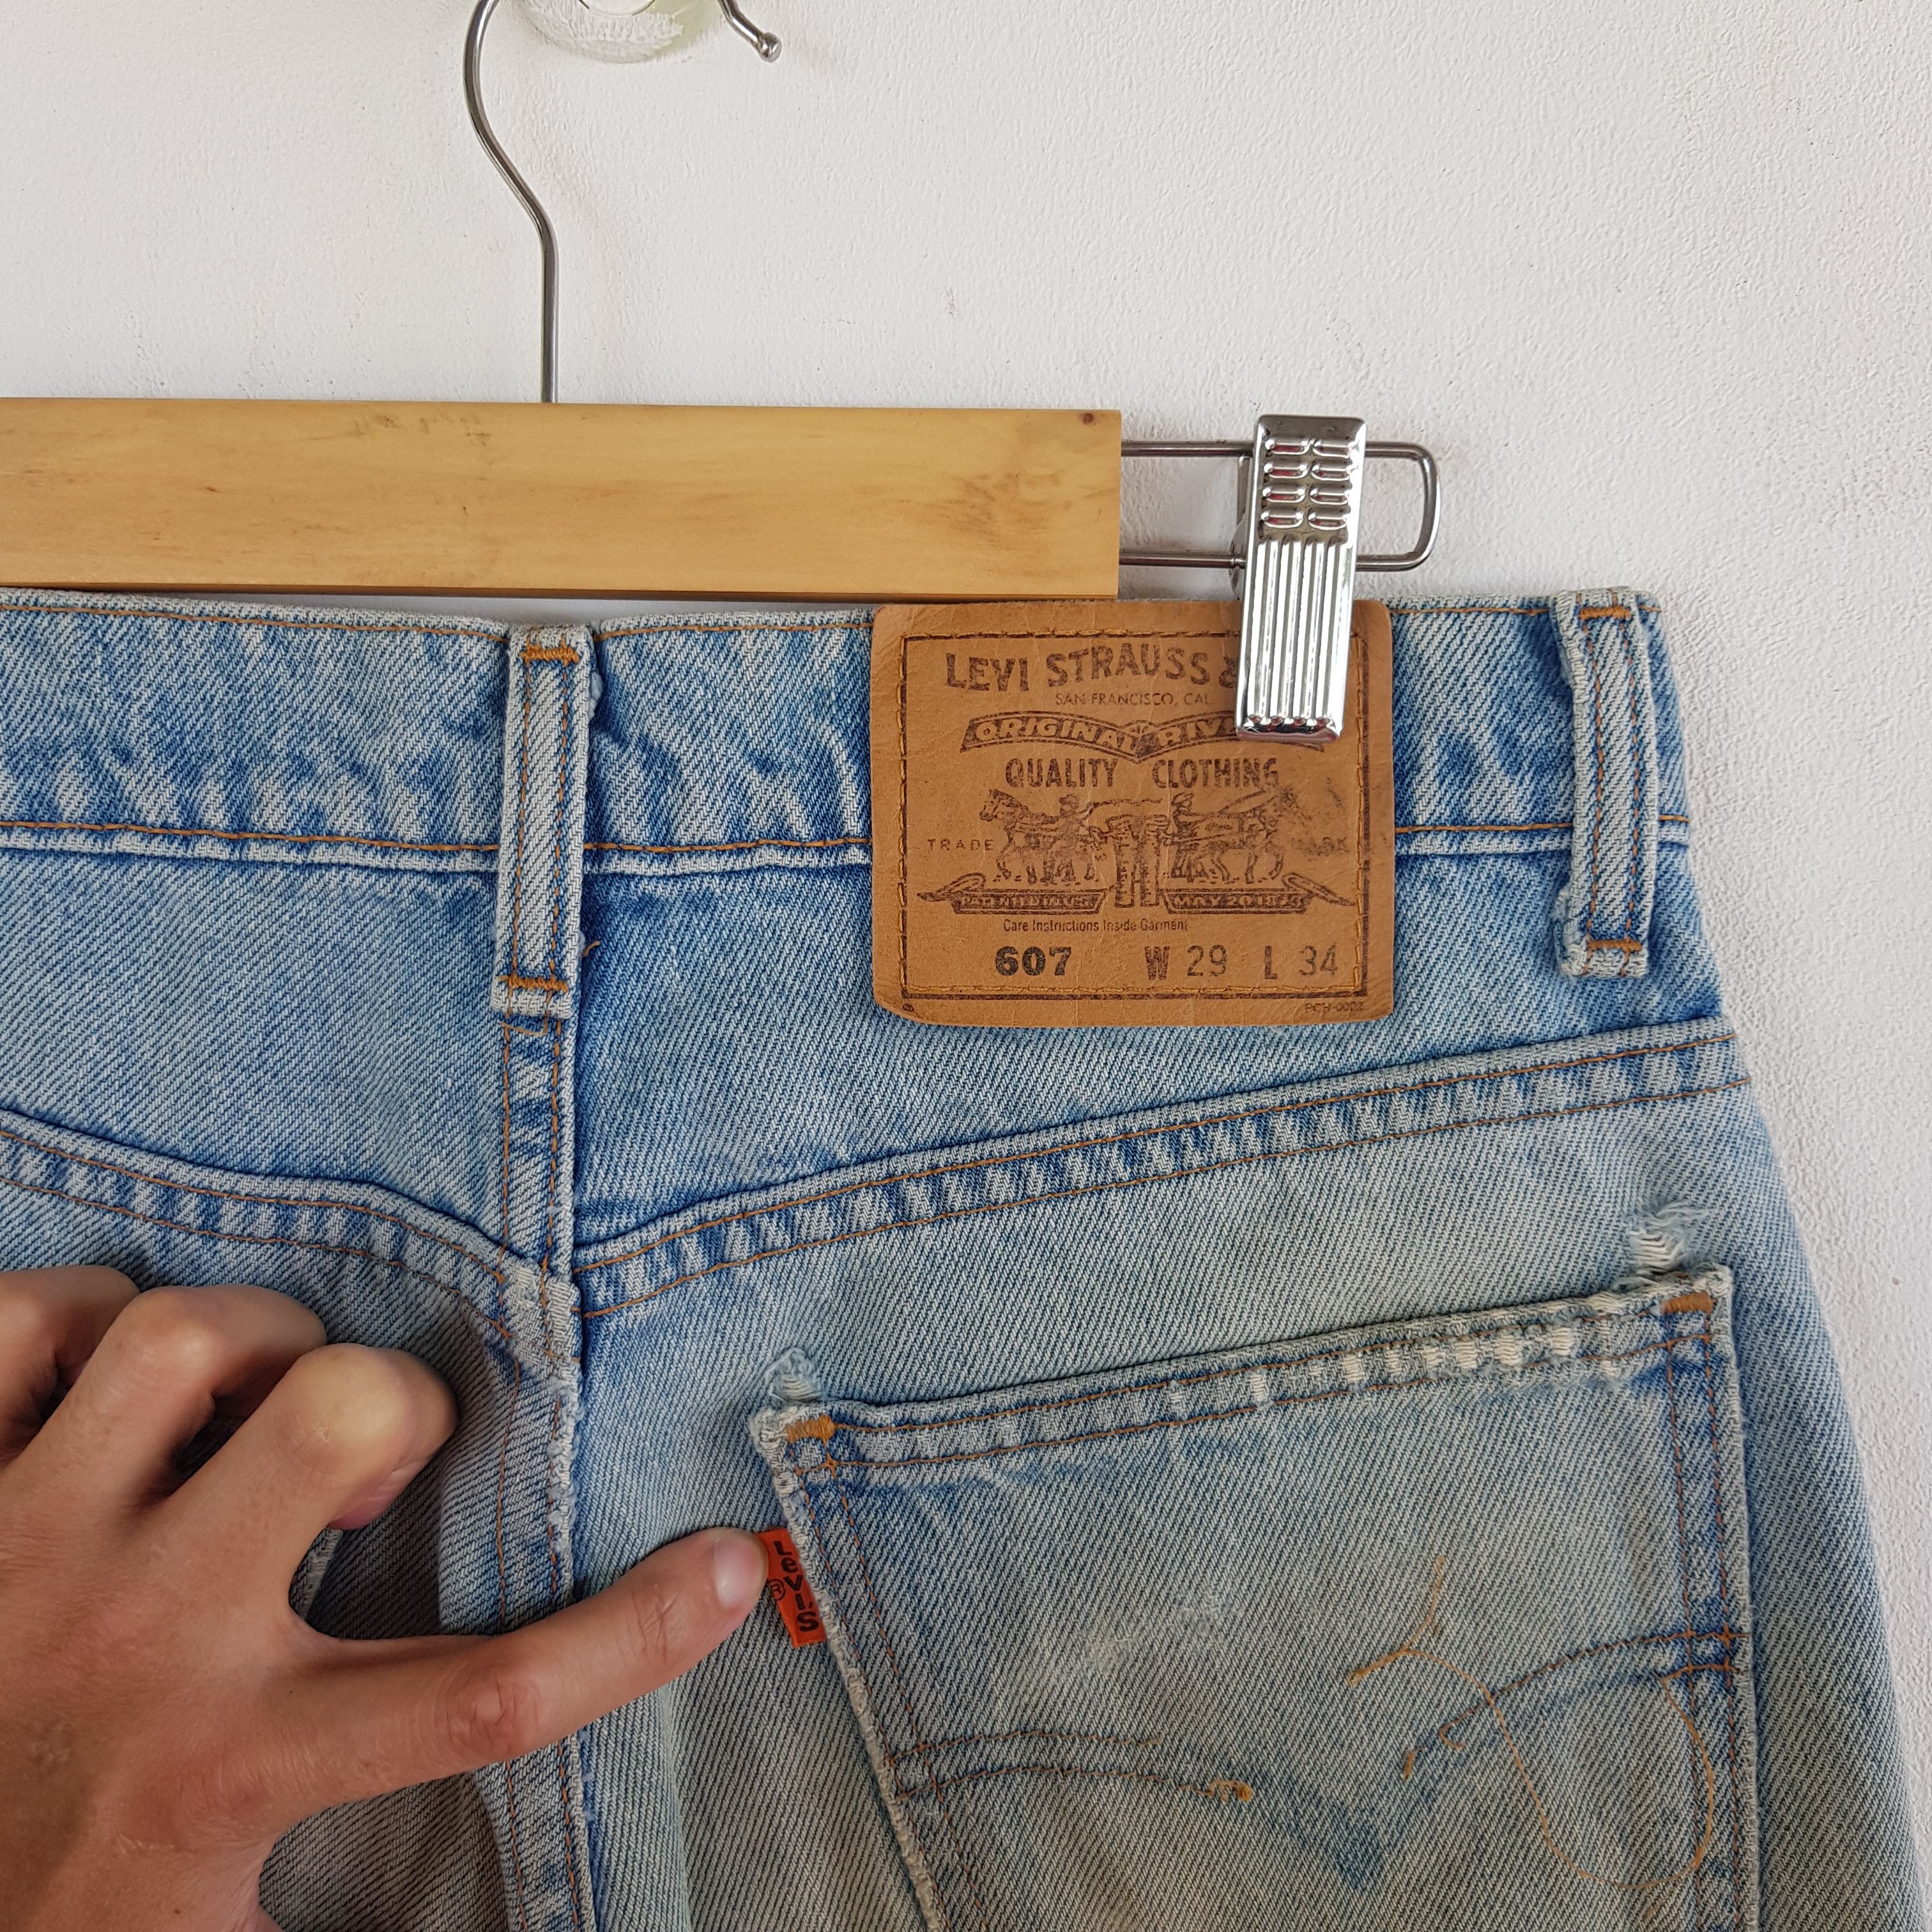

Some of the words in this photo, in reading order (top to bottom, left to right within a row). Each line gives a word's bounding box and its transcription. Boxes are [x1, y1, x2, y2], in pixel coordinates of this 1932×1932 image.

[946, 653, 1029, 691] LEVI
[1046, 643, 1210, 687] STRAUSS
[1055, 693, 1085, 705] SAN
[1091, 692, 1177, 706] FRANCISCO,
[976, 717, 1135, 755] ORIGINAL
[1006, 758, 1117, 787] QUALITY
[1153, 757, 1278, 789] CLOTHING
[927, 838, 993, 851] TRADE
[1174, 896, 1221, 907] MAY
[1227, 896, 1252, 907] 20
[1003, 919, 1029, 932] Care
[1032, 919, 1100, 932] Instructions
[1103, 918, 1137, 931] Inside
[1140, 918, 1189, 931] Garment
[994, 946, 1072, 977] 607
[1144, 946, 1170, 981] W
[1186, 945, 1227, 977] 29
[1264, 946, 1278, 979] L
[1299, 942, 1338, 977] 34
